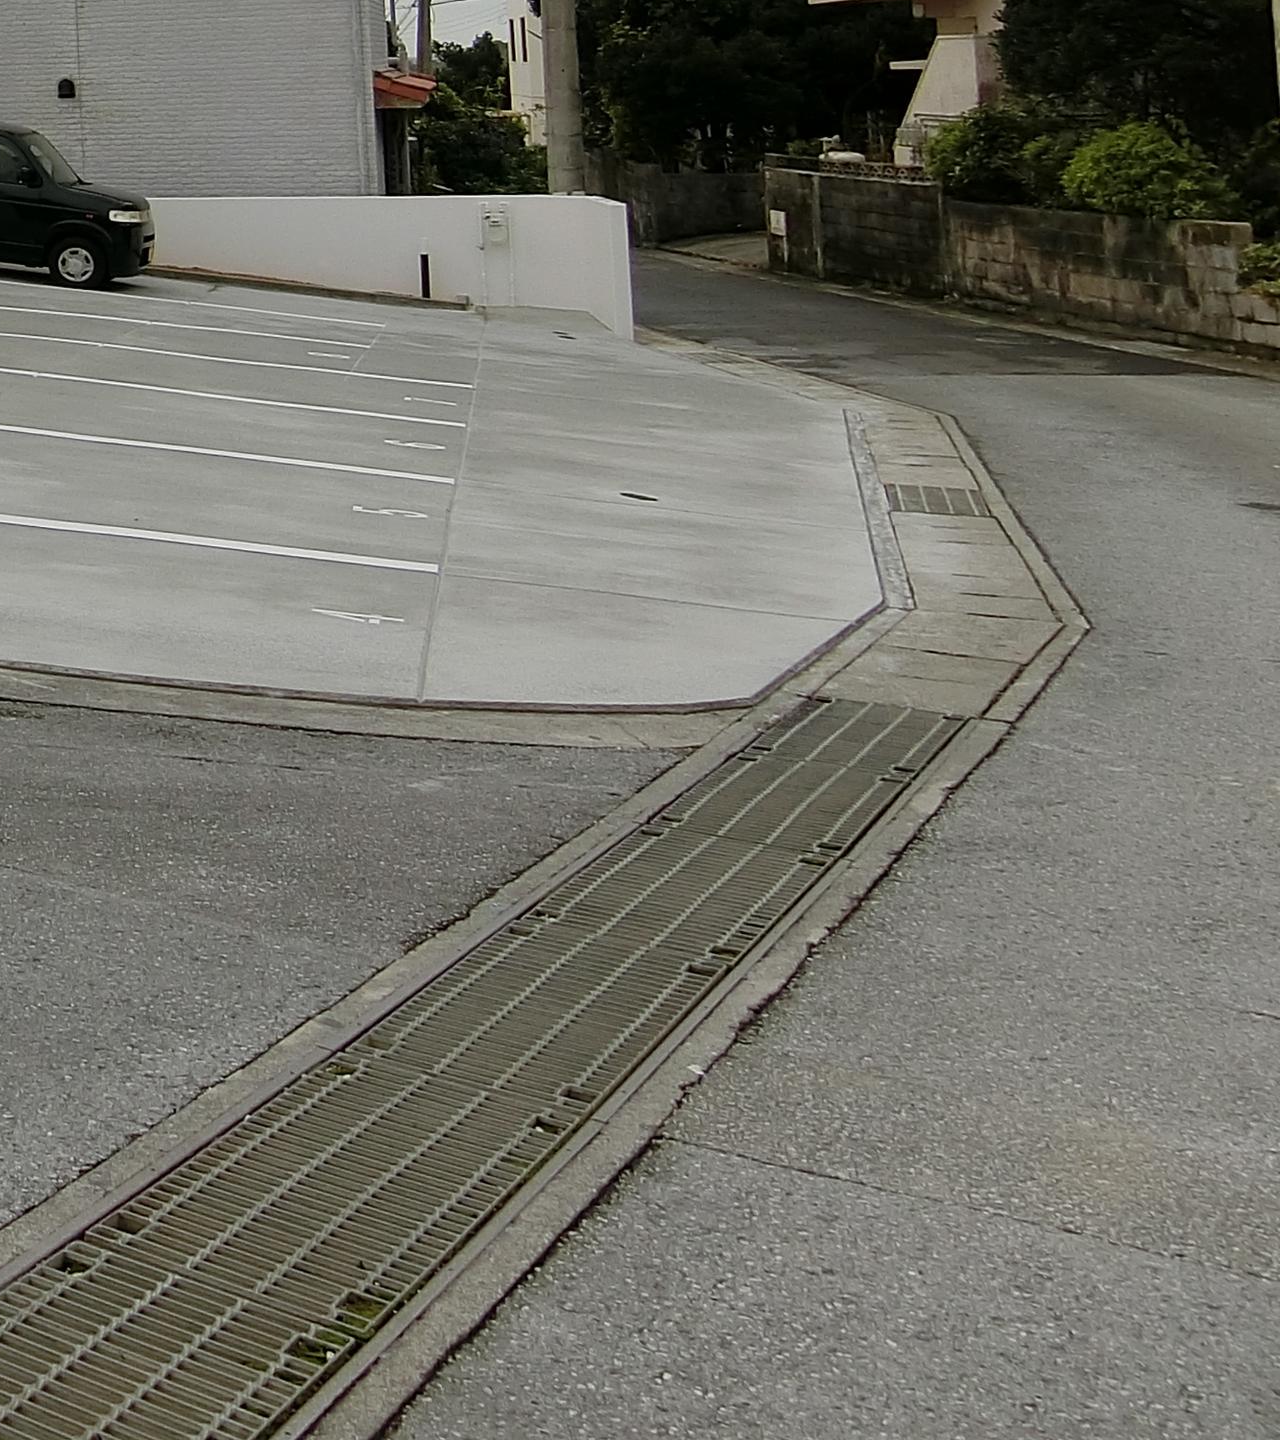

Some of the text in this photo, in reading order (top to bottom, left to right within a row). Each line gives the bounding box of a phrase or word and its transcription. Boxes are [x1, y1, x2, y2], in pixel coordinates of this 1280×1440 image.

[384, 438, 447, 450] 6
[352, 505, 429, 519] 5
[311, 608, 406, 625] 4
